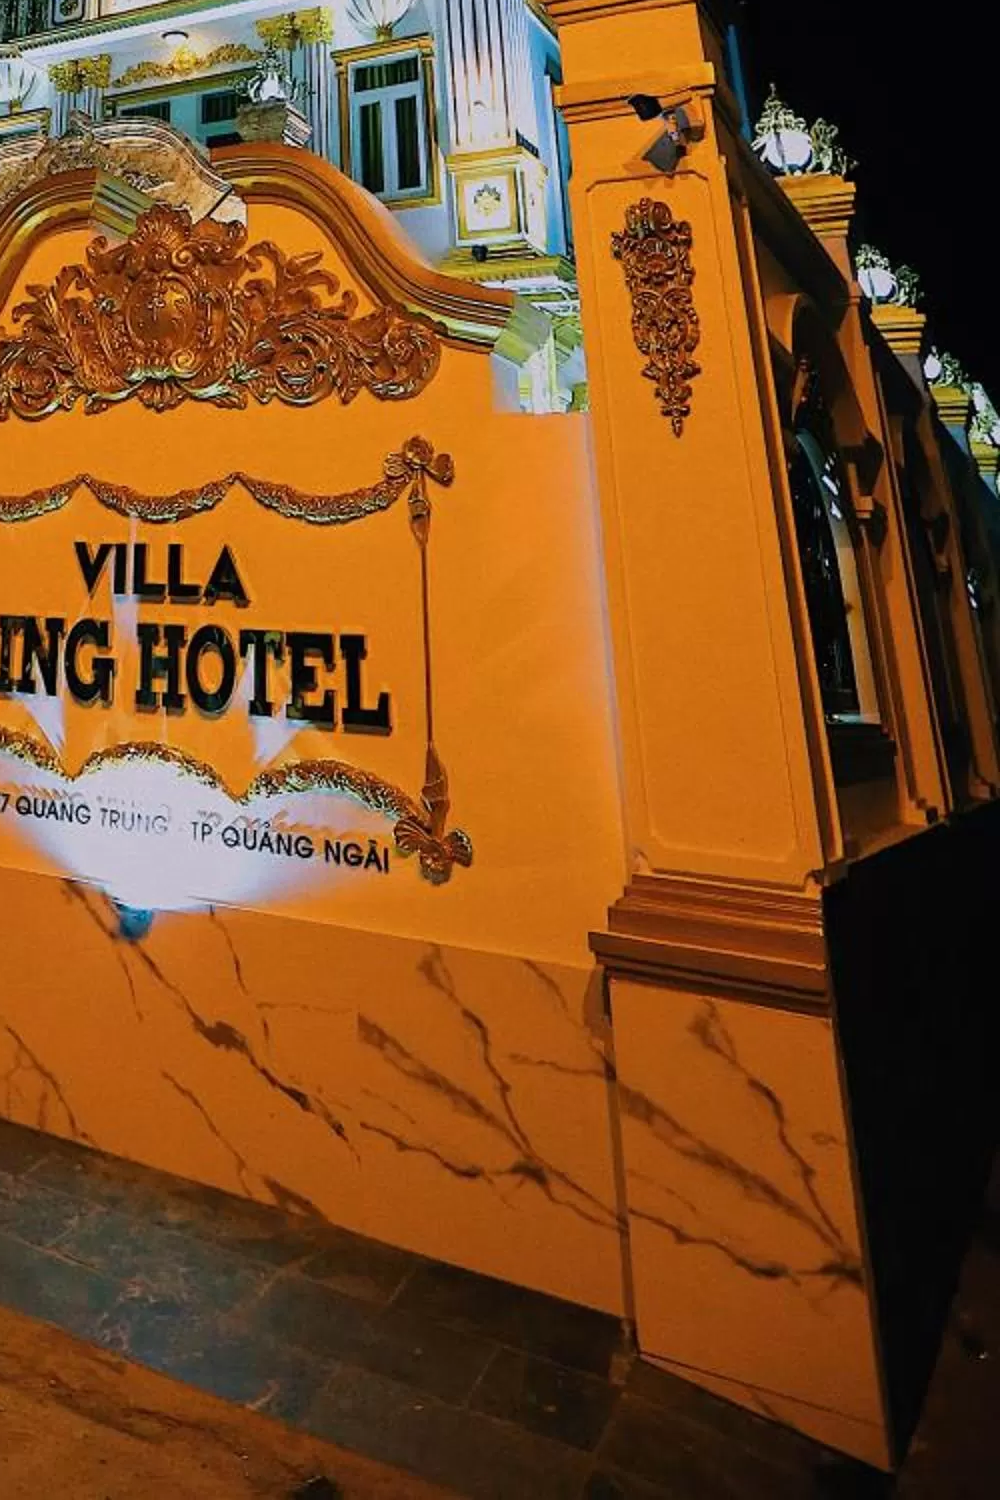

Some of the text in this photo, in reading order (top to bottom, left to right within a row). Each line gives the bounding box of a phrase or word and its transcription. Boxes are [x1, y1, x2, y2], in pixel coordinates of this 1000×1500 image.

[74, 541, 250, 608] VILLA
[135, 622, 392, 736] HOTEL
[15, 795, 92, 825] QUANG
[99, 807, 170, 835] TRUNG
[191, 821, 213, 842] TP
